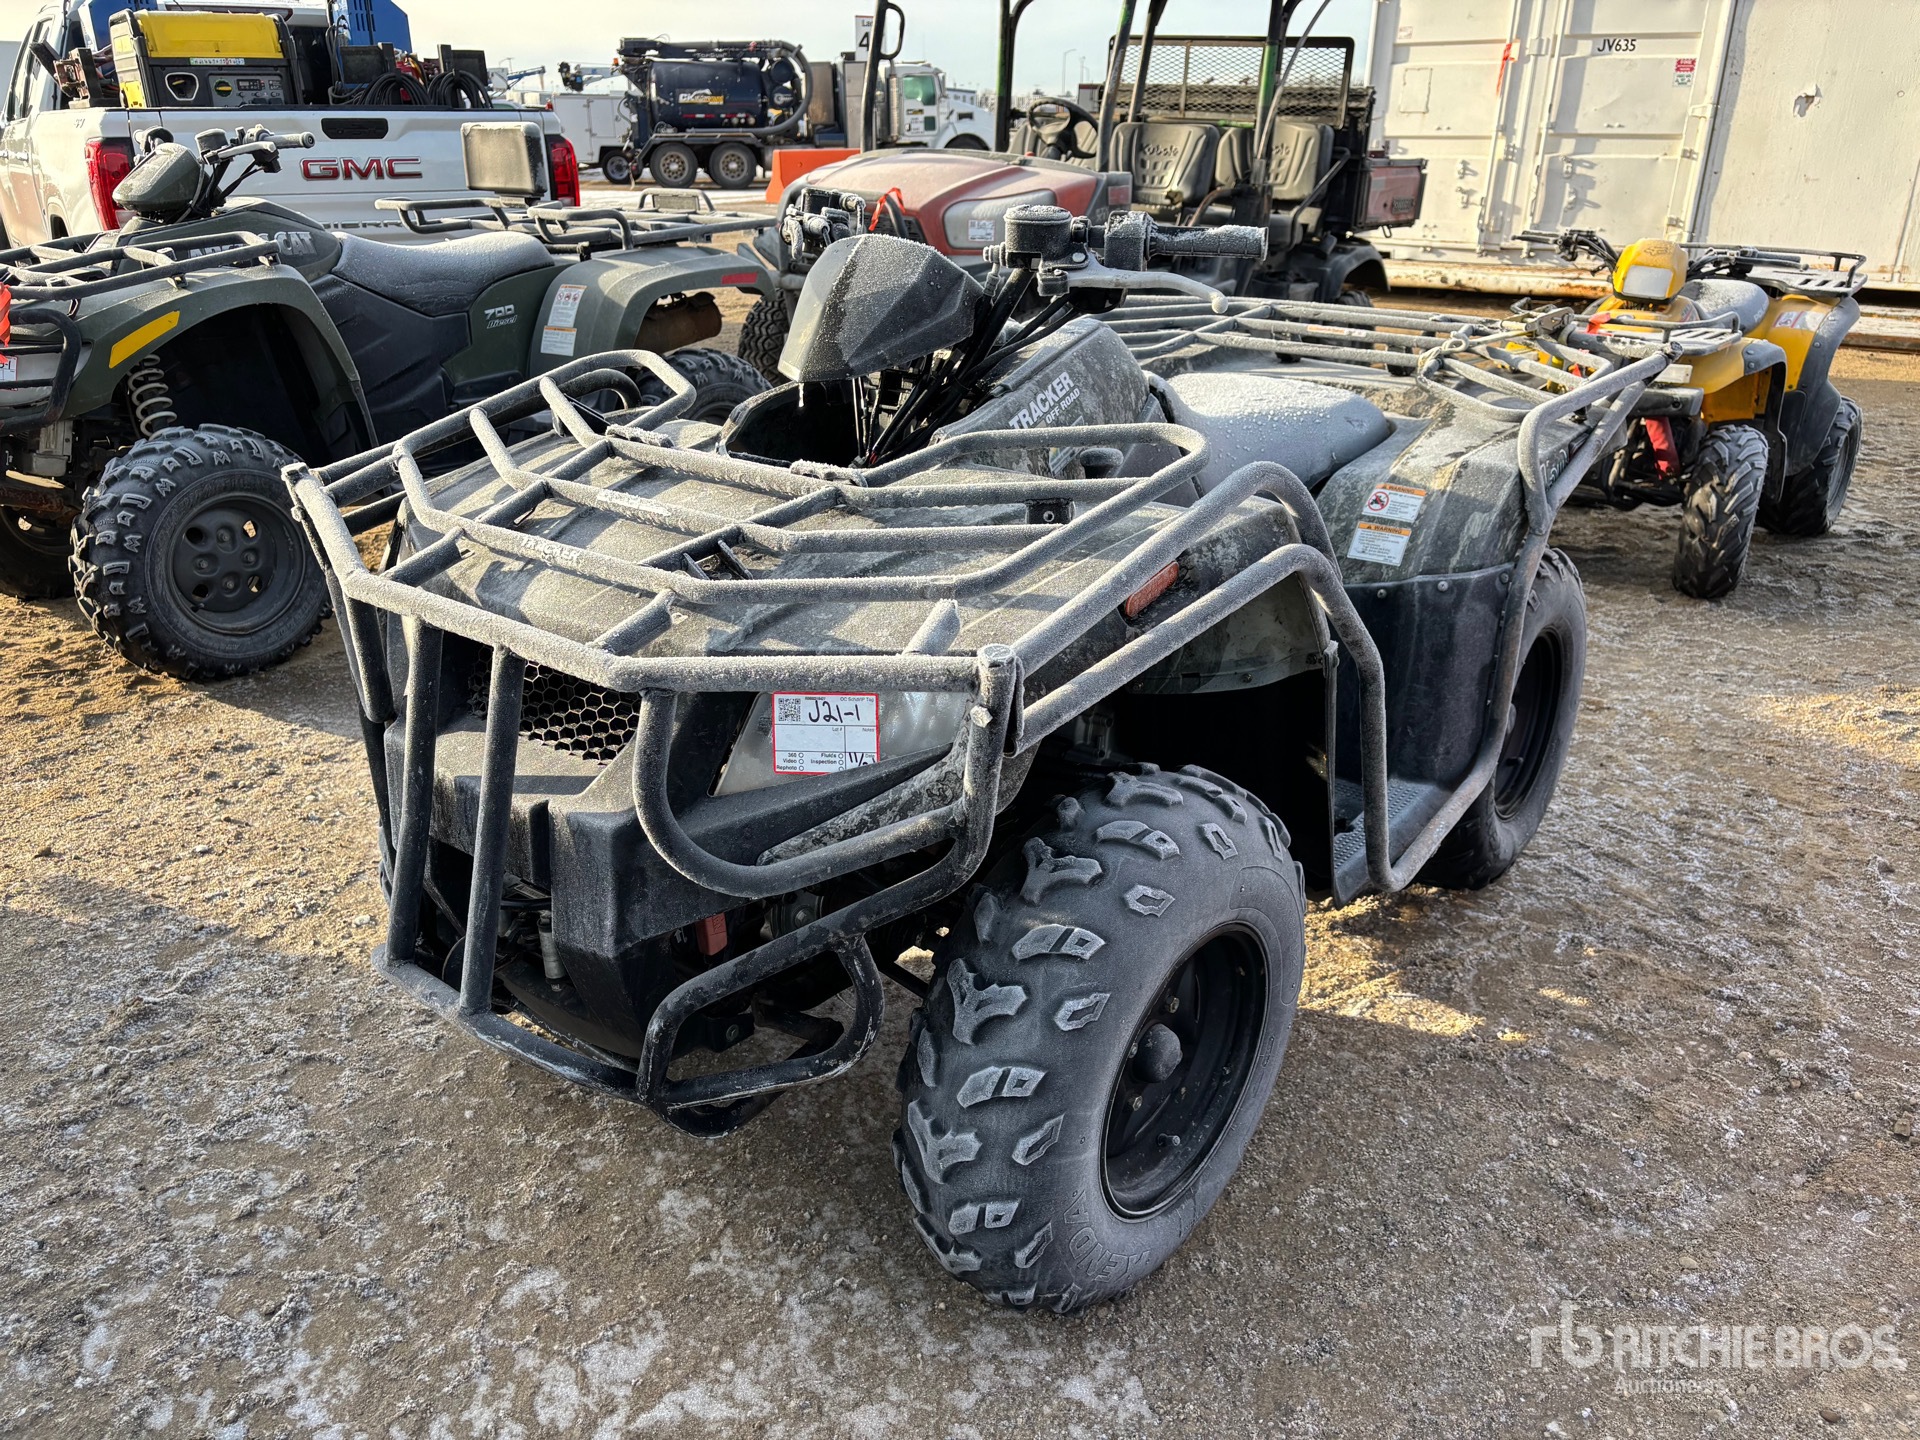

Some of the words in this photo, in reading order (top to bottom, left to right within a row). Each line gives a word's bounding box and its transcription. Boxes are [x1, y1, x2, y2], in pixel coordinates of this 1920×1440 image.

[1597, 38, 1637, 52] JV635
[300, 157, 422, 181] GMC
[274, 231, 318, 255] CAT
[484, 304, 515, 319] 700
[1008, 371, 1074, 430] TRACKER
[1045, 405, 1061, 424] OFF
[1059, 388, 1081, 411] ROAD
[1374, 525, 1402, 534] WARNING
[808, 700, 861, 723] J21-1
